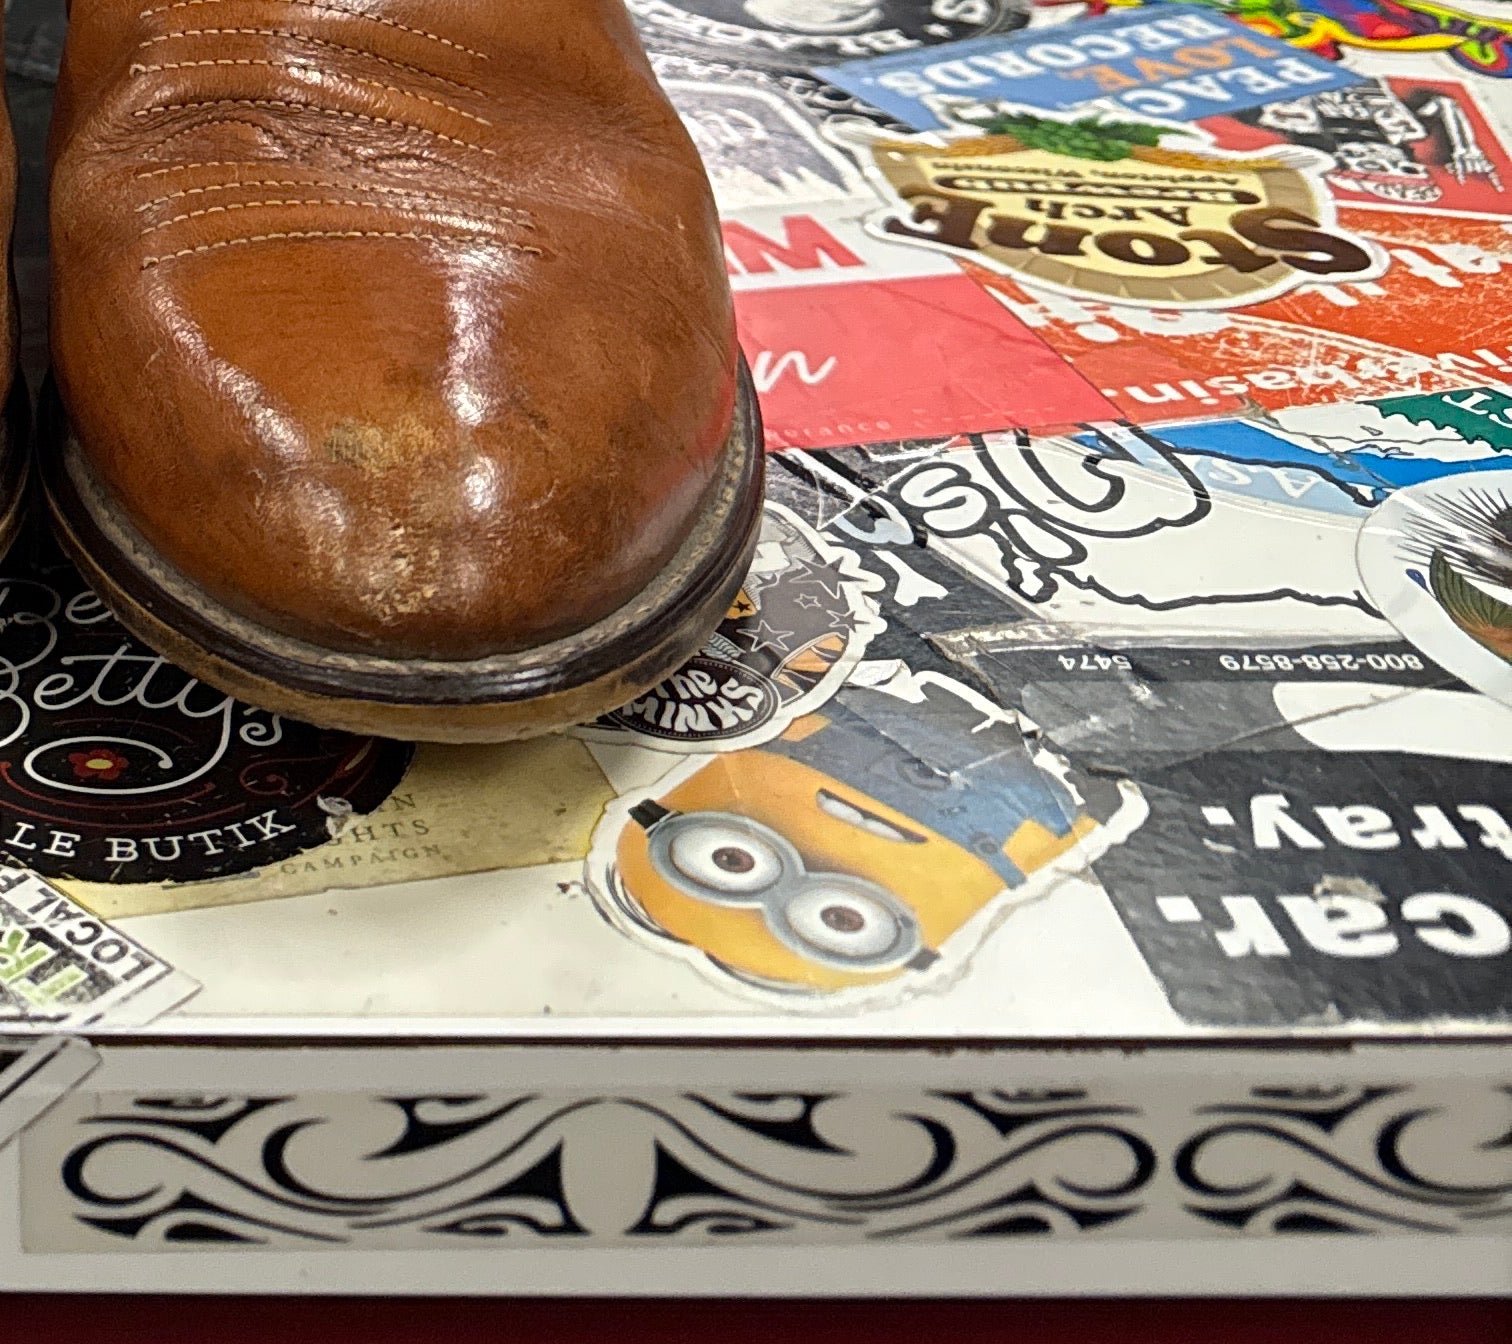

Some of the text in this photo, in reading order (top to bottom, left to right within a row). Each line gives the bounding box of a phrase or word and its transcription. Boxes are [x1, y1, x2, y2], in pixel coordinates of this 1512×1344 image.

[1060, 56, 1336, 116] PEAC
[1026, 197, 1192, 227] Arch
[1057, 652, 1132, 672] 5474
[1219, 652, 1423, 672] 800-258-8579
[104, 809, 297, 864] BUTIK
[279, 843, 441, 876] CAMPAIGN
[26, 885, 156, 983] LOCAL
